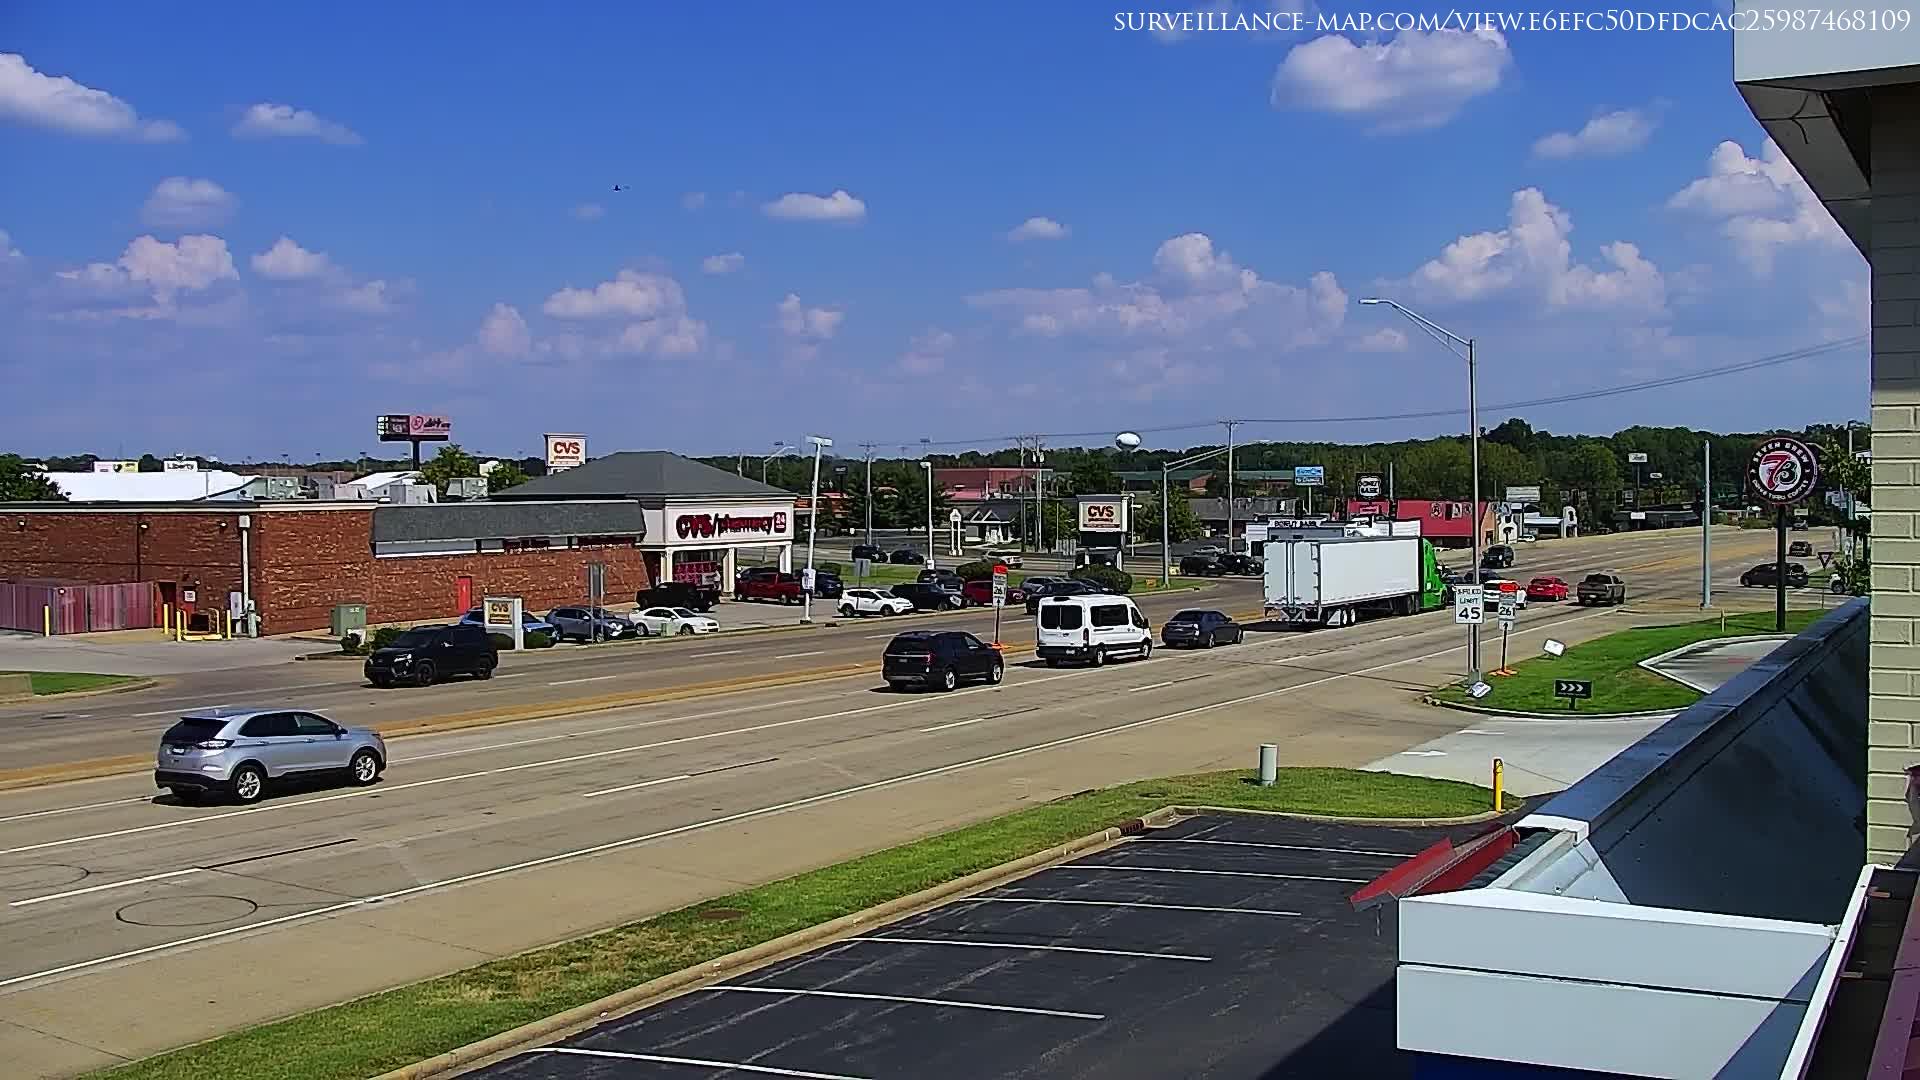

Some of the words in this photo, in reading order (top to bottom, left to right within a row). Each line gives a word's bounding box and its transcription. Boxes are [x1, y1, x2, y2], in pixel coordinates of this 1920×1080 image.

[553, 441, 580, 454] CVS
[1087, 505, 1114, 518] CVS
[491, 602, 509, 613] CVS
[1459, 597, 1479, 605] LIMIT
[1458, 606, 1481, 620] 45
